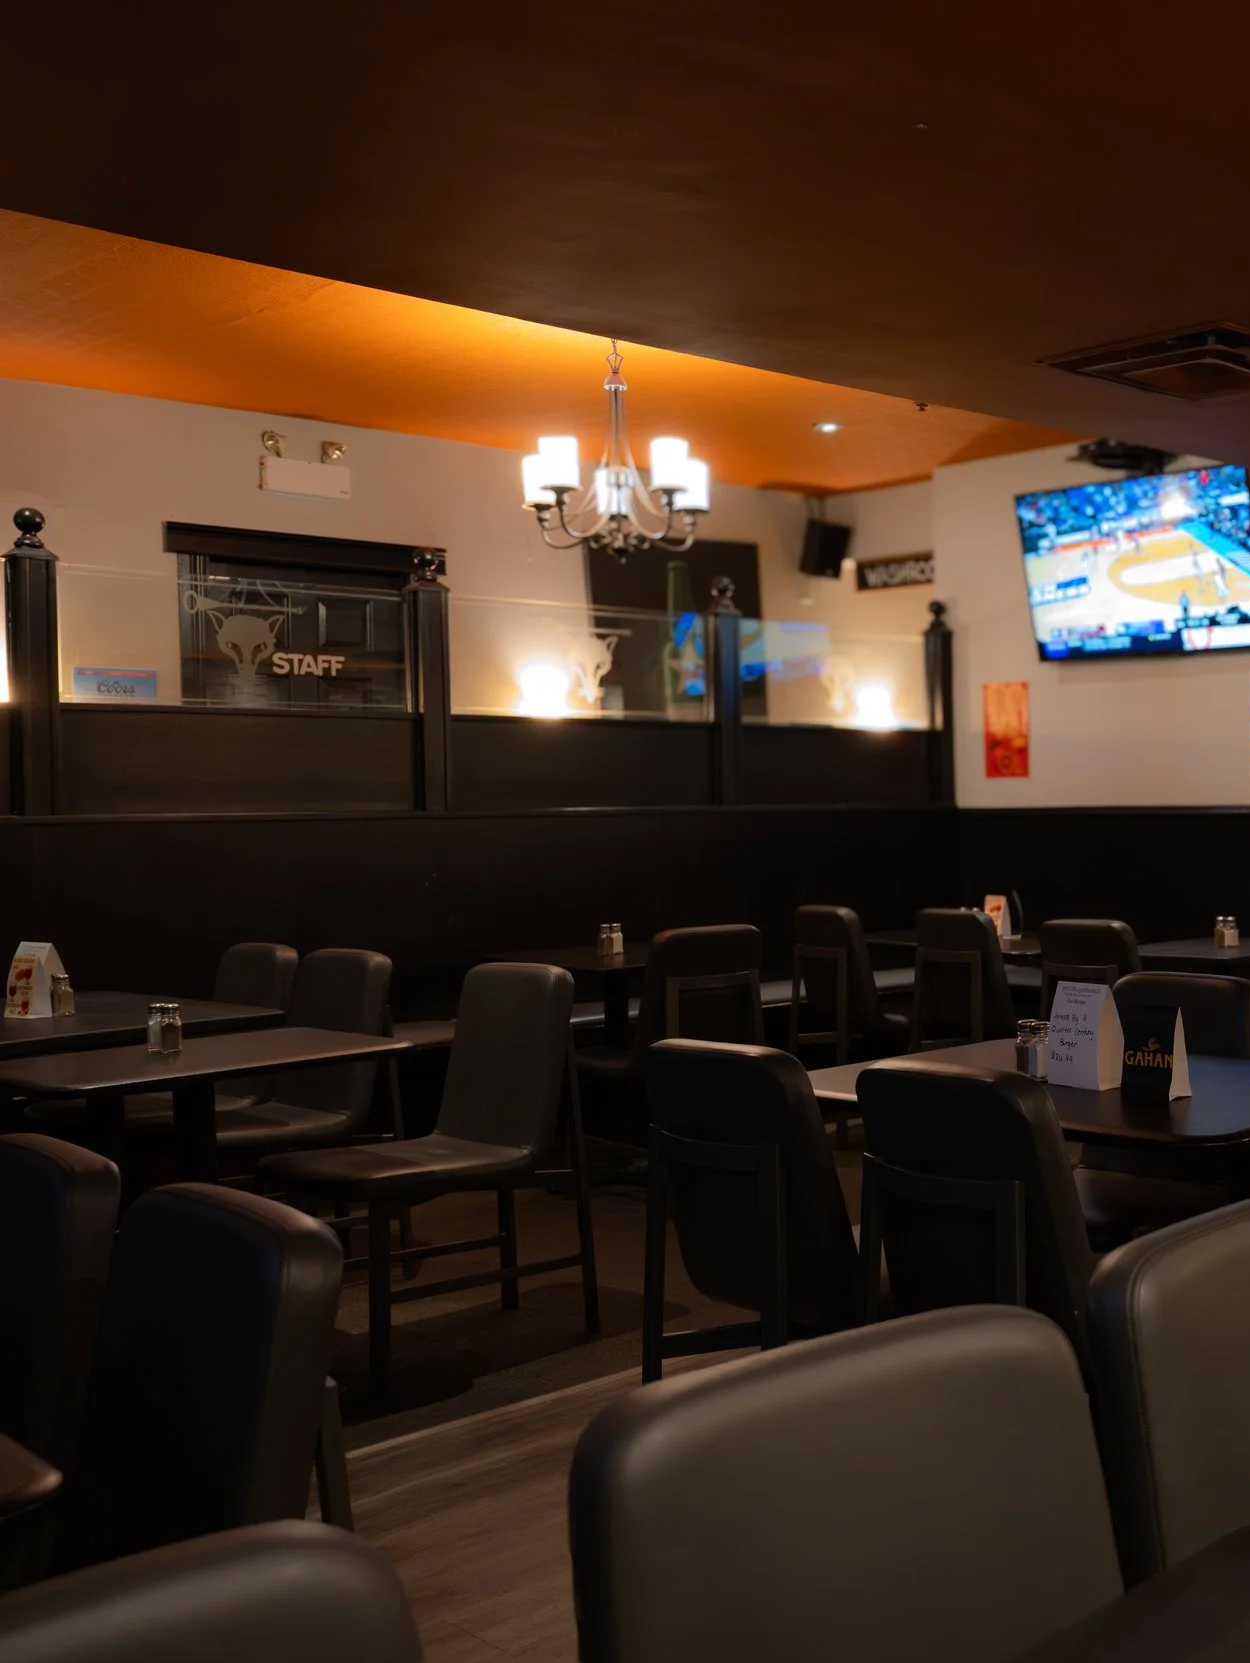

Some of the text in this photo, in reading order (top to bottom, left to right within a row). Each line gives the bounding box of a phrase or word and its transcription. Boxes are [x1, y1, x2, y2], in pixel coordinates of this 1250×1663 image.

[271, 652, 345, 677] STAFF
[96, 680, 136, 694] Coors
[1060, 1038, 1078, 1050] Burger
[1124, 1050, 1173, 1068] GAHAN
